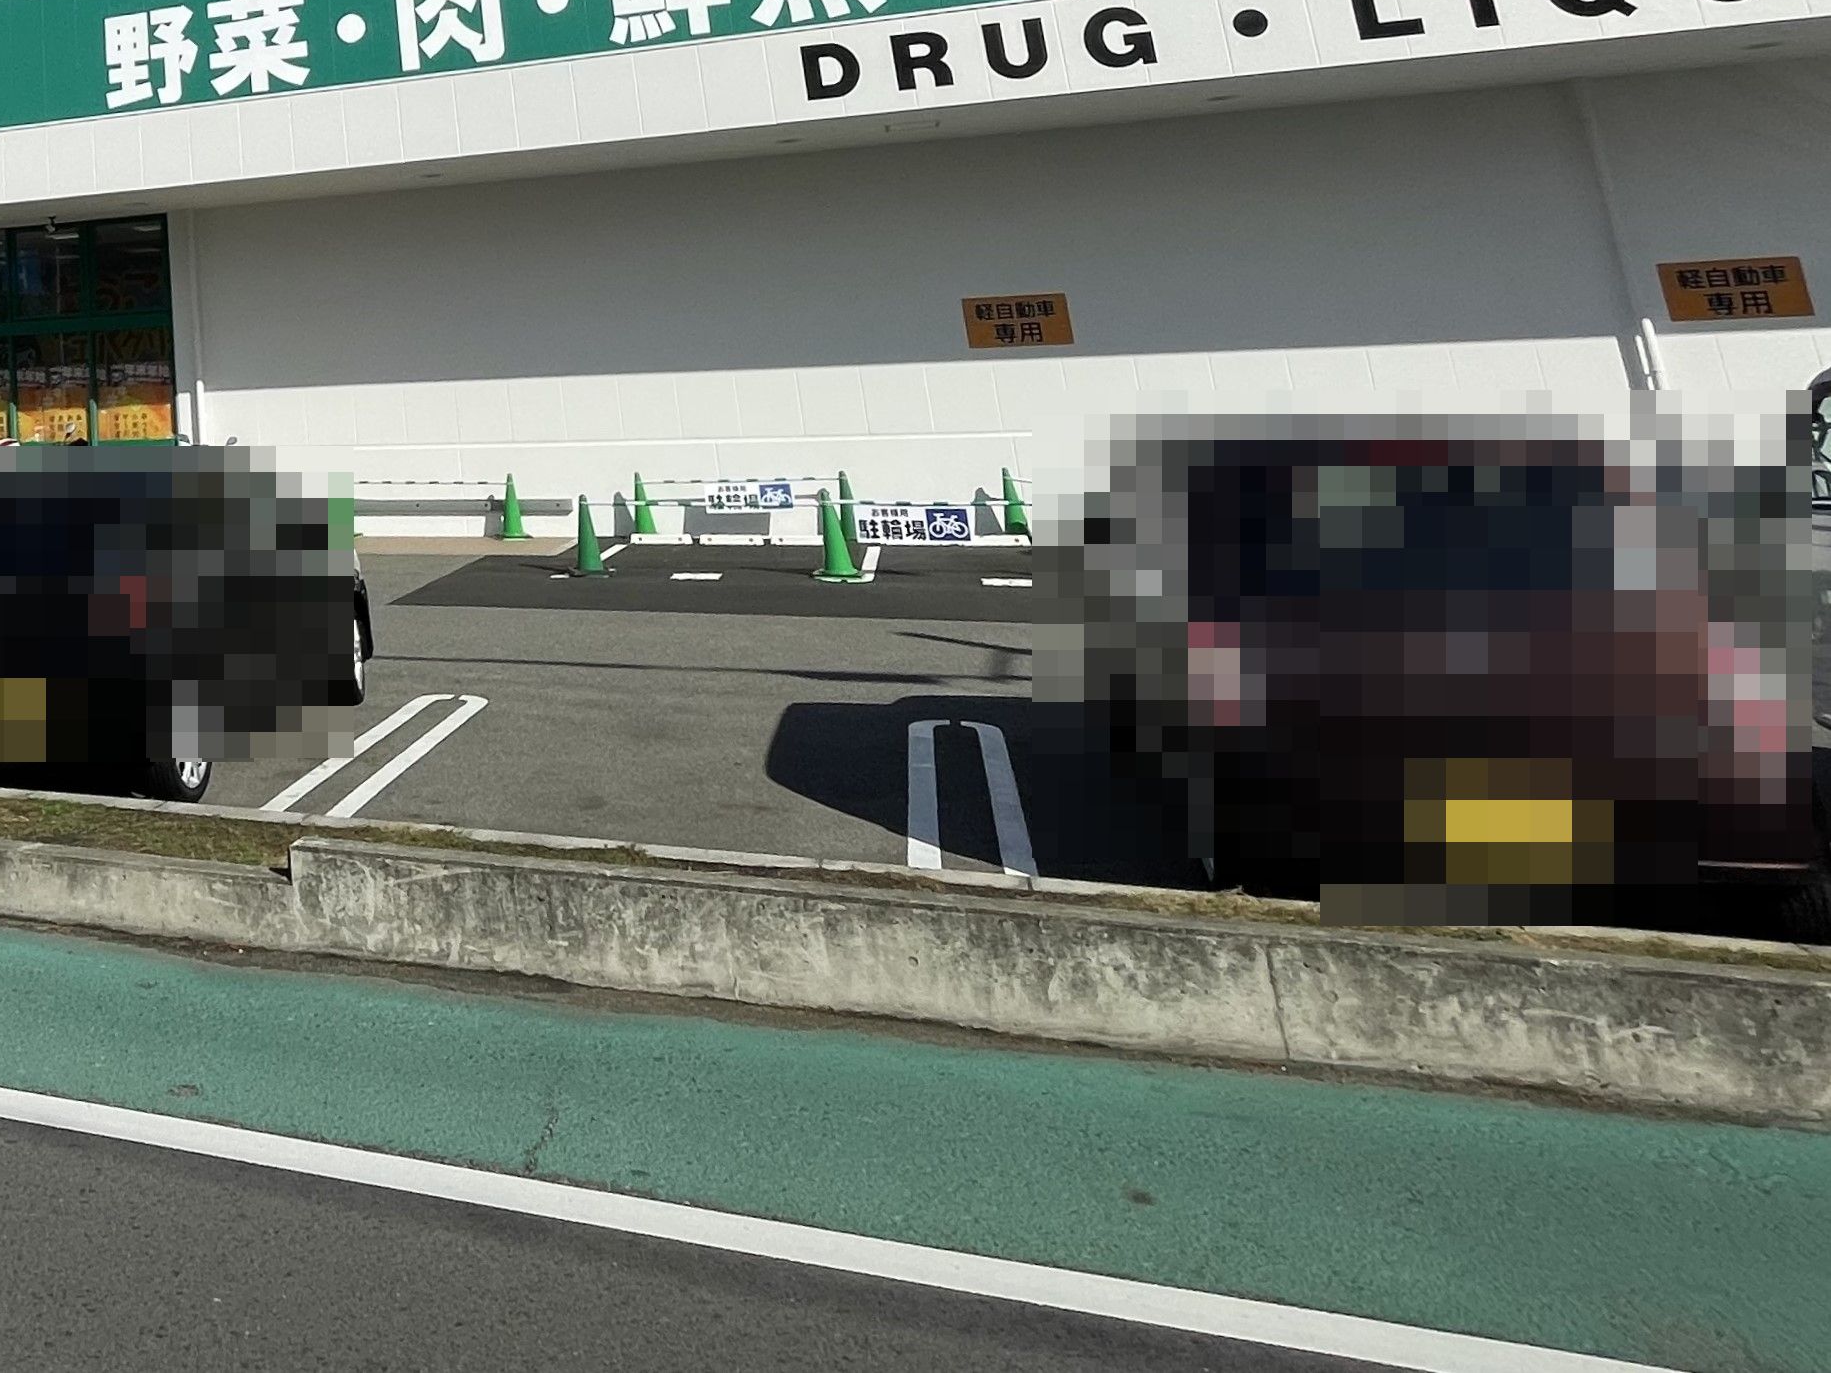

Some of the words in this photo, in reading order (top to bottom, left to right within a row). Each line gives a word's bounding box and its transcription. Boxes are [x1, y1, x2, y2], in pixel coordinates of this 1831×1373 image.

[800, 5, 1158, 102] DRUG
[1675, 264, 1789, 290] 軽自動車
[974, 299, 1057, 321] 軽自動車
[1703, 290, 1774, 316] 専用
[993, 321, 1044, 343] 専用
[858, 518, 928, 541] 駐輪場
